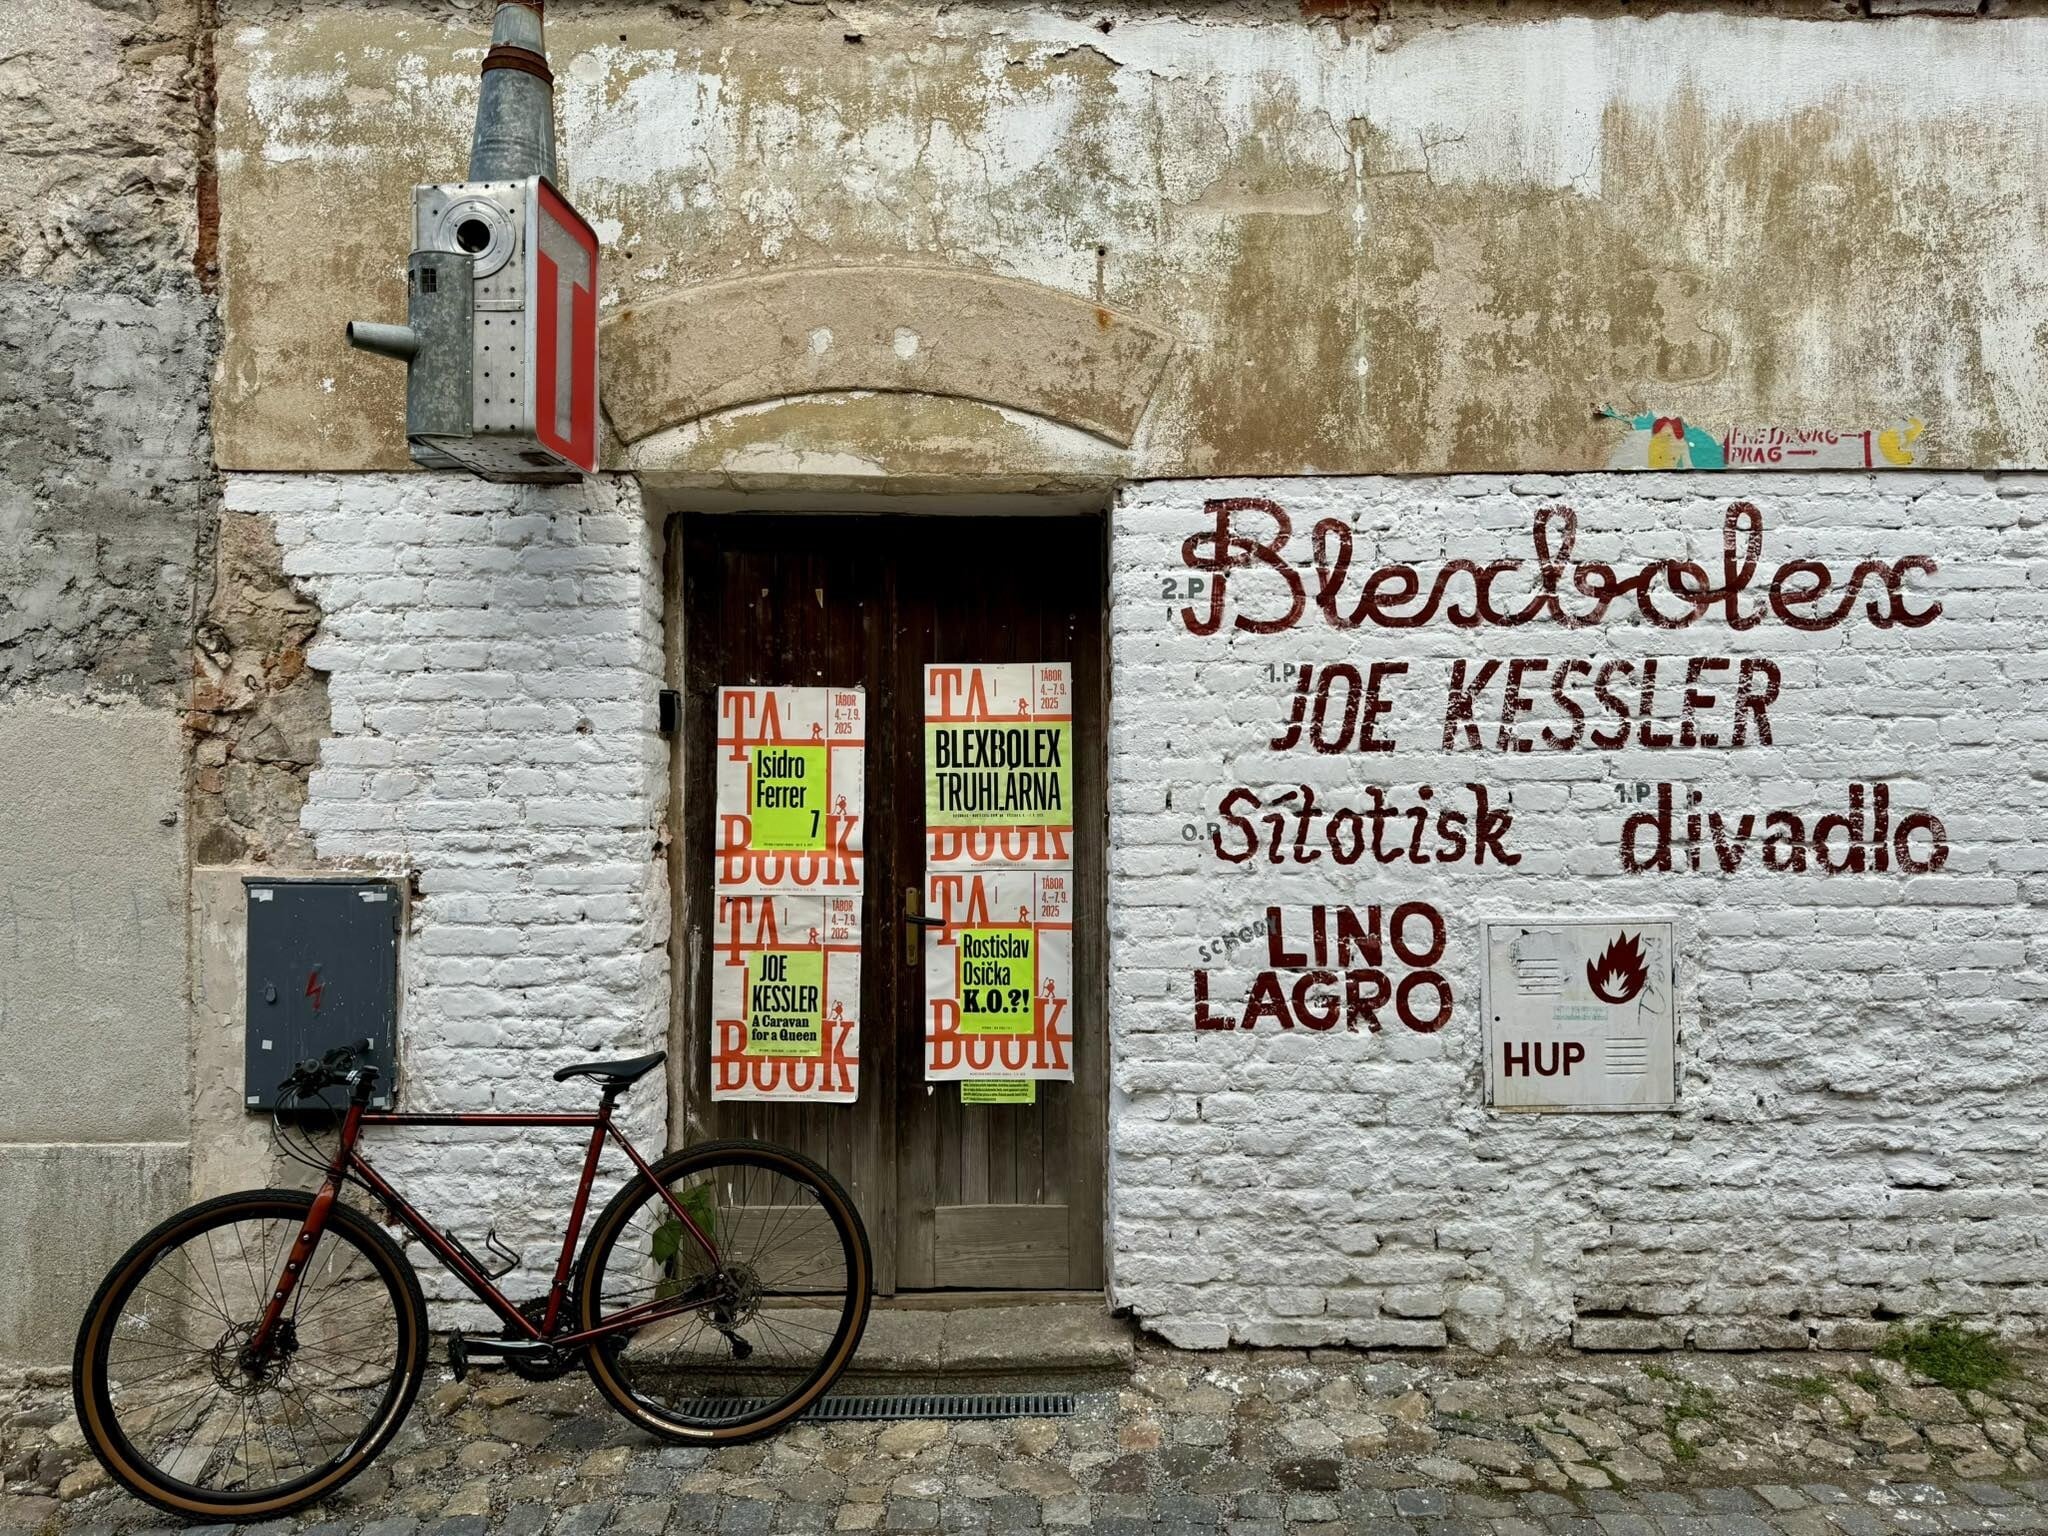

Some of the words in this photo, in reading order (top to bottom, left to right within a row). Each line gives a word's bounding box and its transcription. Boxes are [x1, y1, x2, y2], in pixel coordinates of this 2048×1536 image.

[1731, 447, 1783, 463] PRAG
[1181, 498, 1944, 637] Blexbolex
[1161, 577, 1205, 600] 2.P
[1040, 668, 1062, 682] TÁBOR
[1263, 663, 1297, 683] 1.P
[834, 693, 857, 706] TÁBOR
[1040, 697, 1059, 709] 2025
[1270, 661, 1409, 755] JOE
[1442, 657, 1782, 753] KESSLER
[834, 722, 853, 735] 2025
[935, 729, 1062, 769] BLEXBOLEX
[757, 749, 806, 779] Isidro
[756, 779, 808, 809] Ferrer
[810, 809, 821, 838] 7
[1212, 784, 1523, 866] Sítotisk
[1619, 782, 1949, 874] divadlo
[1042, 876, 1064, 889] TÁBOR
[832, 898, 854, 912] TÁBOR
[1041, 905, 1060, 917] 2025
[831, 927, 849, 940] 2025
[963, 933, 1031, 959] Rostislav
[1266, 901, 1447, 968] LINO
[759, 955, 789, 982] JOE
[963, 960, 1011, 986] Osička
[752, 984, 819, 1013] KESSLER
[963, 988, 1031, 1014] K.O.?!
[1194, 969, 1454, 1034] LAGRO
[751, 1014, 761, 1028] A
[762, 1015, 810, 1029] Caravan
[751, 1028, 770, 1042] for
[771, 1031, 778, 1042] a
[779, 1028, 818, 1043] Queen
[1503, 1041, 1586, 1077] HUP
